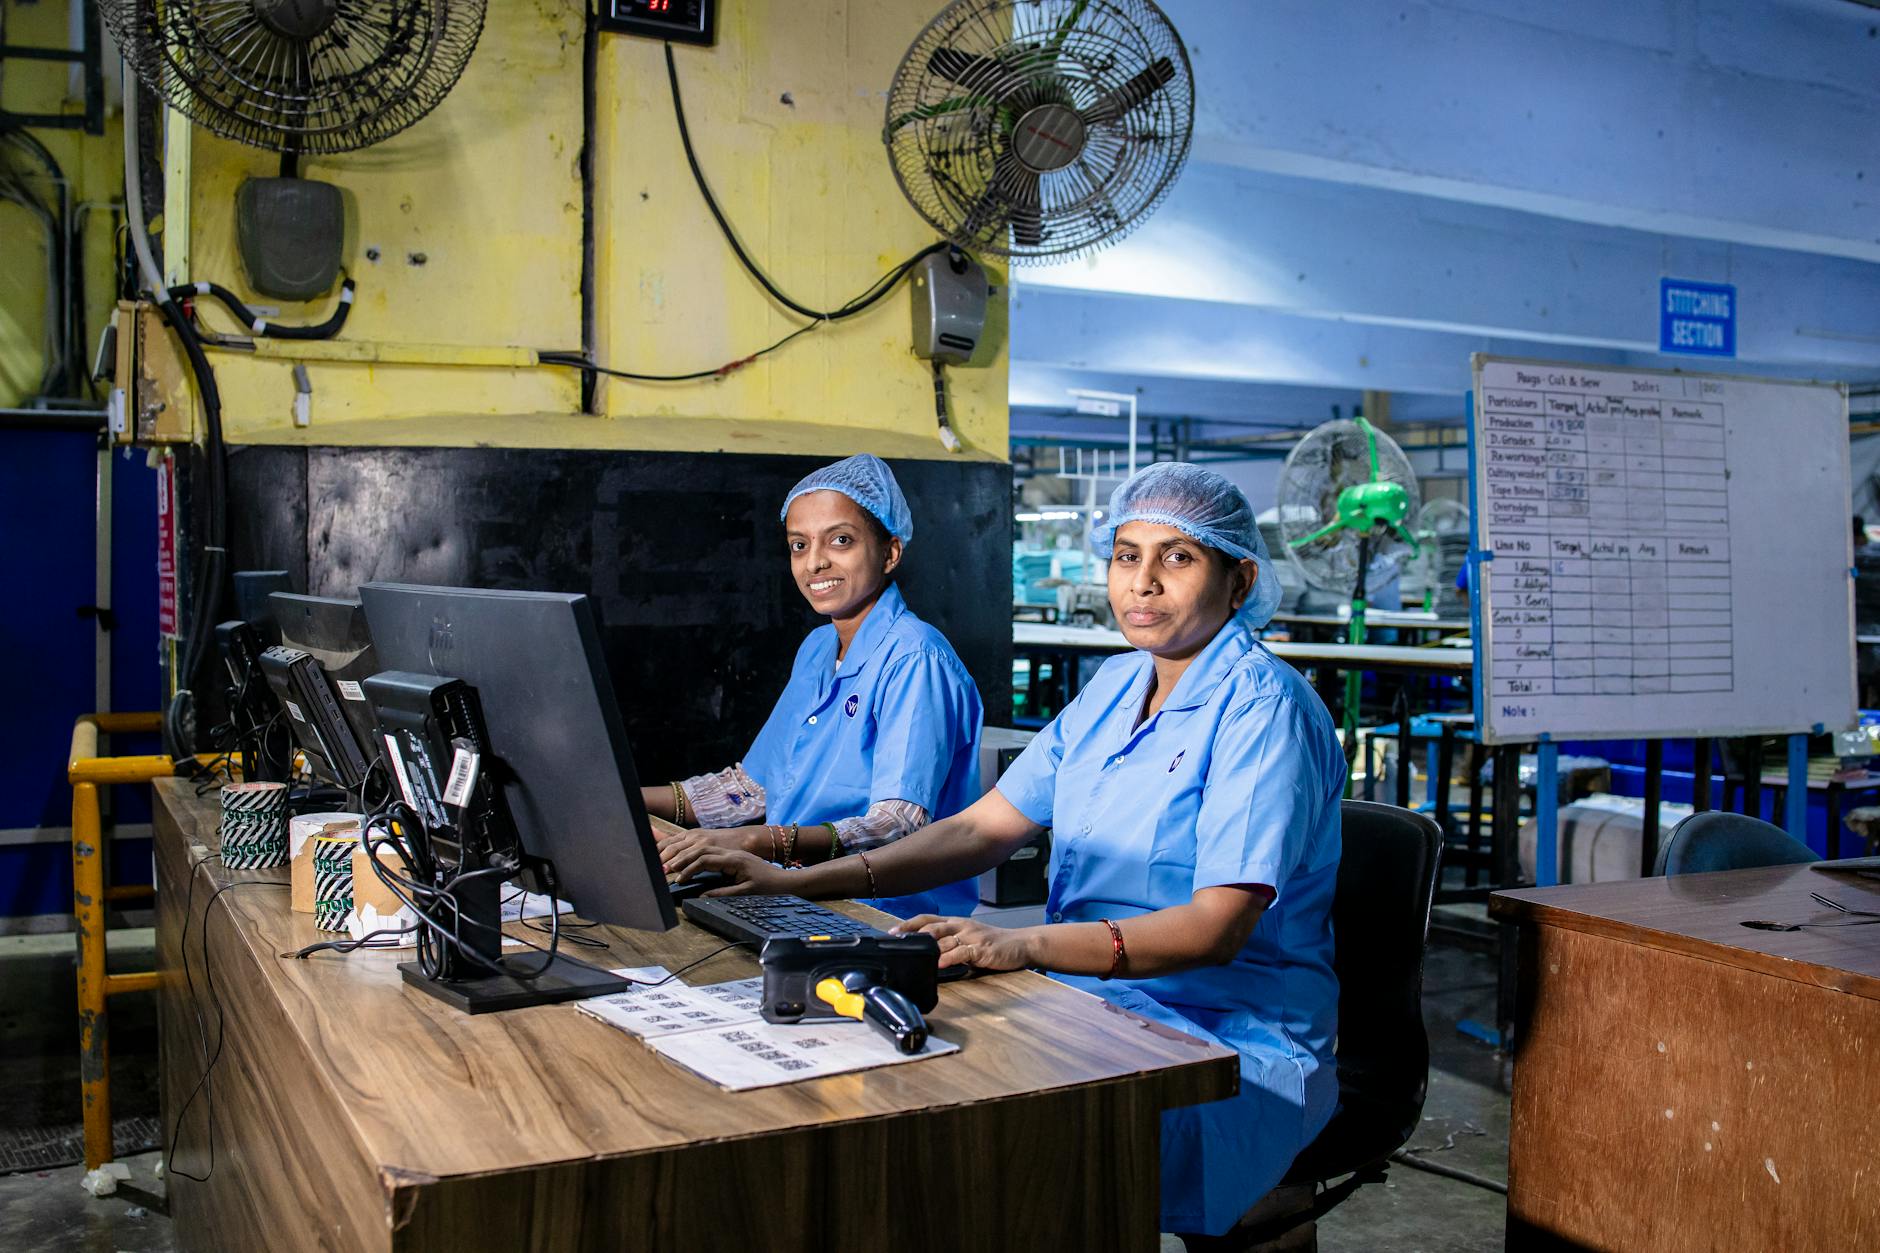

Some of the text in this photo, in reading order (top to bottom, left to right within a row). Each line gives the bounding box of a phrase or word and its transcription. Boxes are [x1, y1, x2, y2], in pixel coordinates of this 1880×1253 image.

[1667, 288, 1730, 318] STITCHING
[1672, 320, 1725, 348] SECTION
[1548, 374, 1566, 385] Cut
[1569, 376, 1577, 386] &
[1581, 377, 1601, 387] Sew
[1487, 394, 1537, 408] Particulars
[1547, 399, 1579, 413] Target
[1672, 406, 1704, 419] Remark
[1489, 416, 1534, 428] Production
[1490, 483, 1511, 499] Tape
[1495, 540, 1531, 551] Line No
[1553, 541, 1582, 555] Target
[1679, 544, 1710, 554] Remark
[1514, 578, 1520, 588] 2
[1514, 594, 1521, 605] 3
[1516, 664, 1522, 674] 7
[1507, 681, 1533, 692] Total
[1502, 705, 1527, 717] Note
